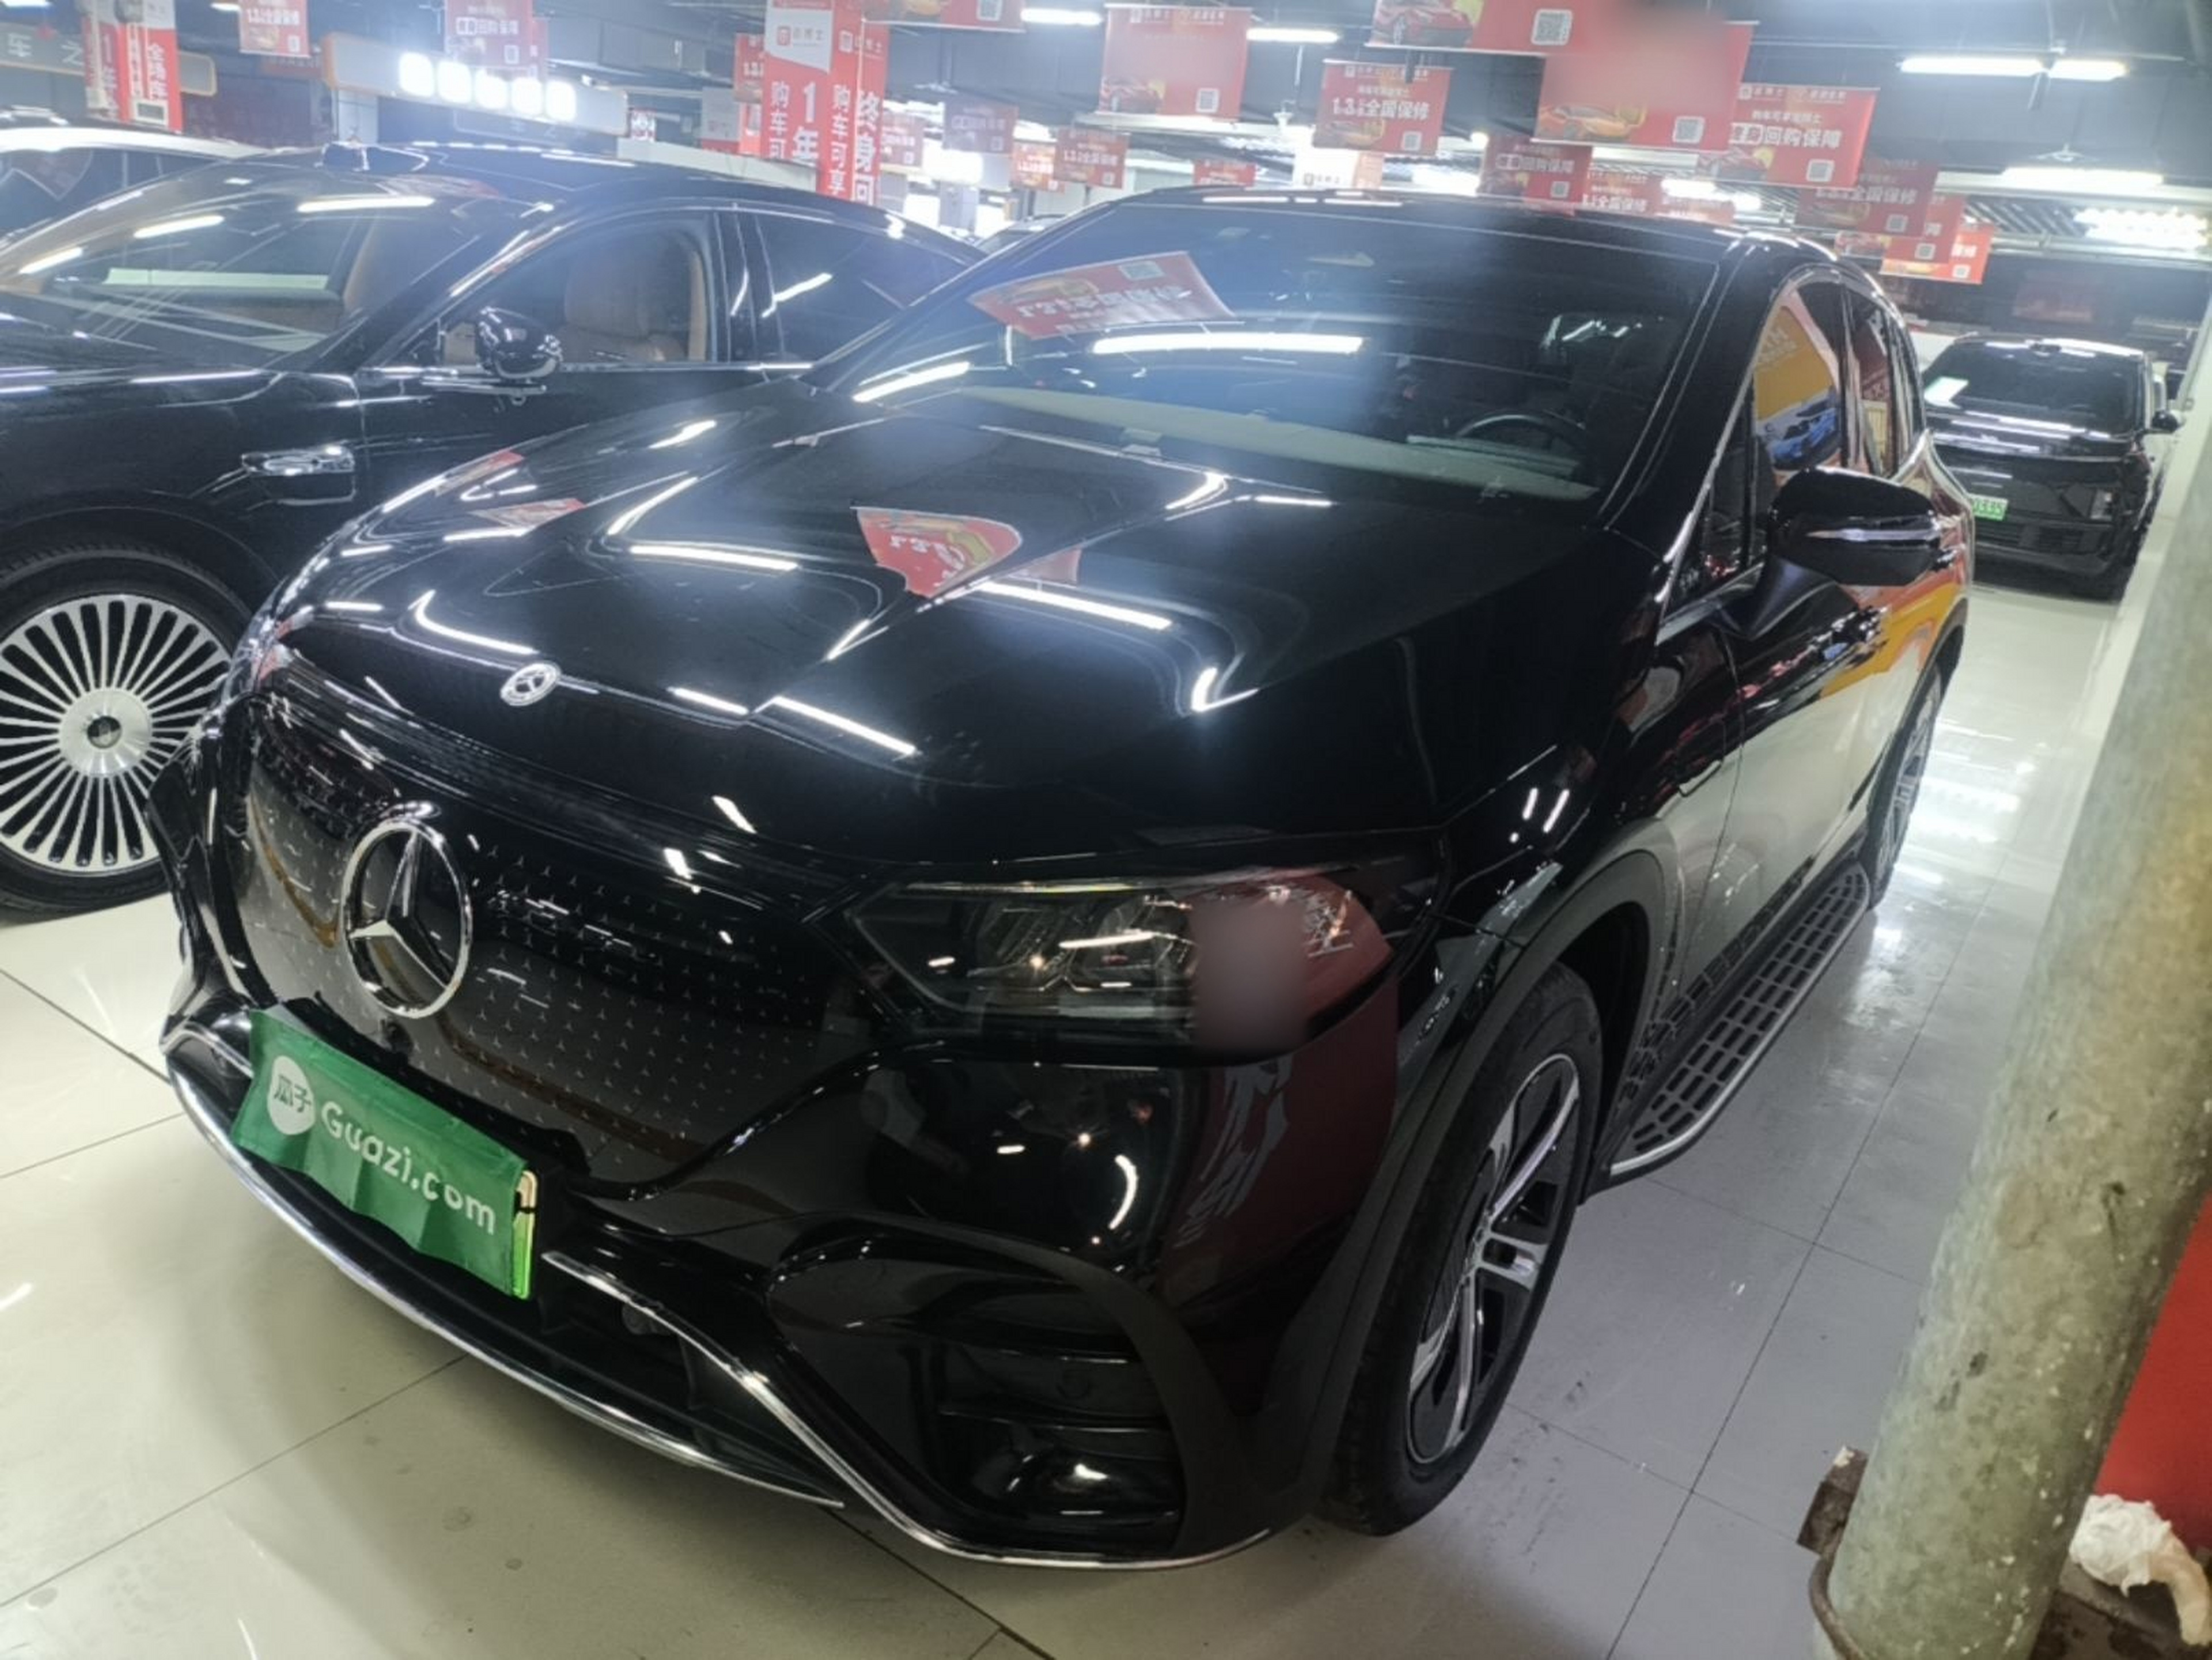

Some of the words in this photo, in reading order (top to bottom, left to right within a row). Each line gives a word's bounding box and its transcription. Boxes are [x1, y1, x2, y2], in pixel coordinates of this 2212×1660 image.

[791, 81, 819, 161] 1年
[827, 84, 851, 196] 购车可享
[273, 1075, 313, 1114] 瓜子
[320, 1100, 497, 1235] Guazi.com
